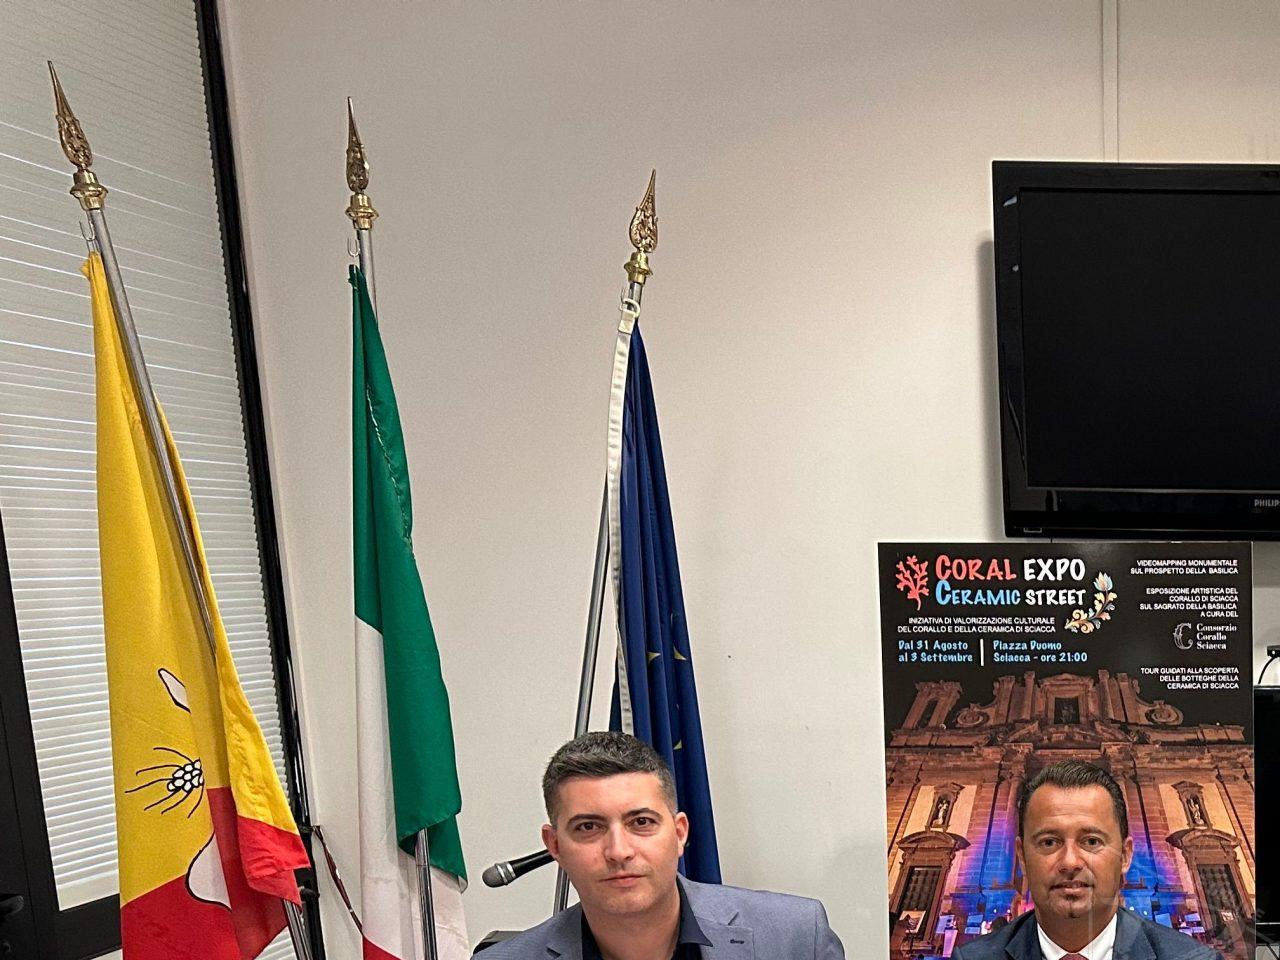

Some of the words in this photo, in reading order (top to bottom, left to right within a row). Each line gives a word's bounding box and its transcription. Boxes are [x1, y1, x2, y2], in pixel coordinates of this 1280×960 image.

[935, 555, 1017, 581] CORAL
[1023, 558, 1086, 581] EXPO
[935, 579, 1021, 605] CERAMIC
[1025, 589, 1087, 605] STREET
[908, 617, 943, 625] INIZIATIVA
[944, 617, 952, 625] DI
[953, 617, 1013, 625] VALORIZZAZIONE
[1013, 617, 1055, 625] CULTURALE
[897, 625, 912, 633] DEL
[912, 625, 947, 633] CORALLO
[948, 625, 953, 633] E
[954, 625, 977, 633] DELLA
[977, 625, 1015, 633] CERAMICA
[1015, 625, 1023, 633] DI
[1024, 625, 1056, 633] SCIACCA
[1196, 623, 1237, 632] Consorzio
[1196, 632, 1227, 641] Corallo
[898, 640, 915, 650] Dal
[917, 640, 929, 650] 31
[933, 640, 968, 653] Agosto
[993, 640, 1028, 650] Piazza
[1030, 640, 1062, 650] Duomo
[1196, 641, 1227, 650] Sciacca
[898, 652, 908, 662] al
[911, 652, 918, 662] 3
[920, 652, 973, 662] Settembre
[993, 652, 1031, 662] Sciacca
[1040, 654, 1057, 662] ore
[1059, 652, 1088, 662] 21:00
